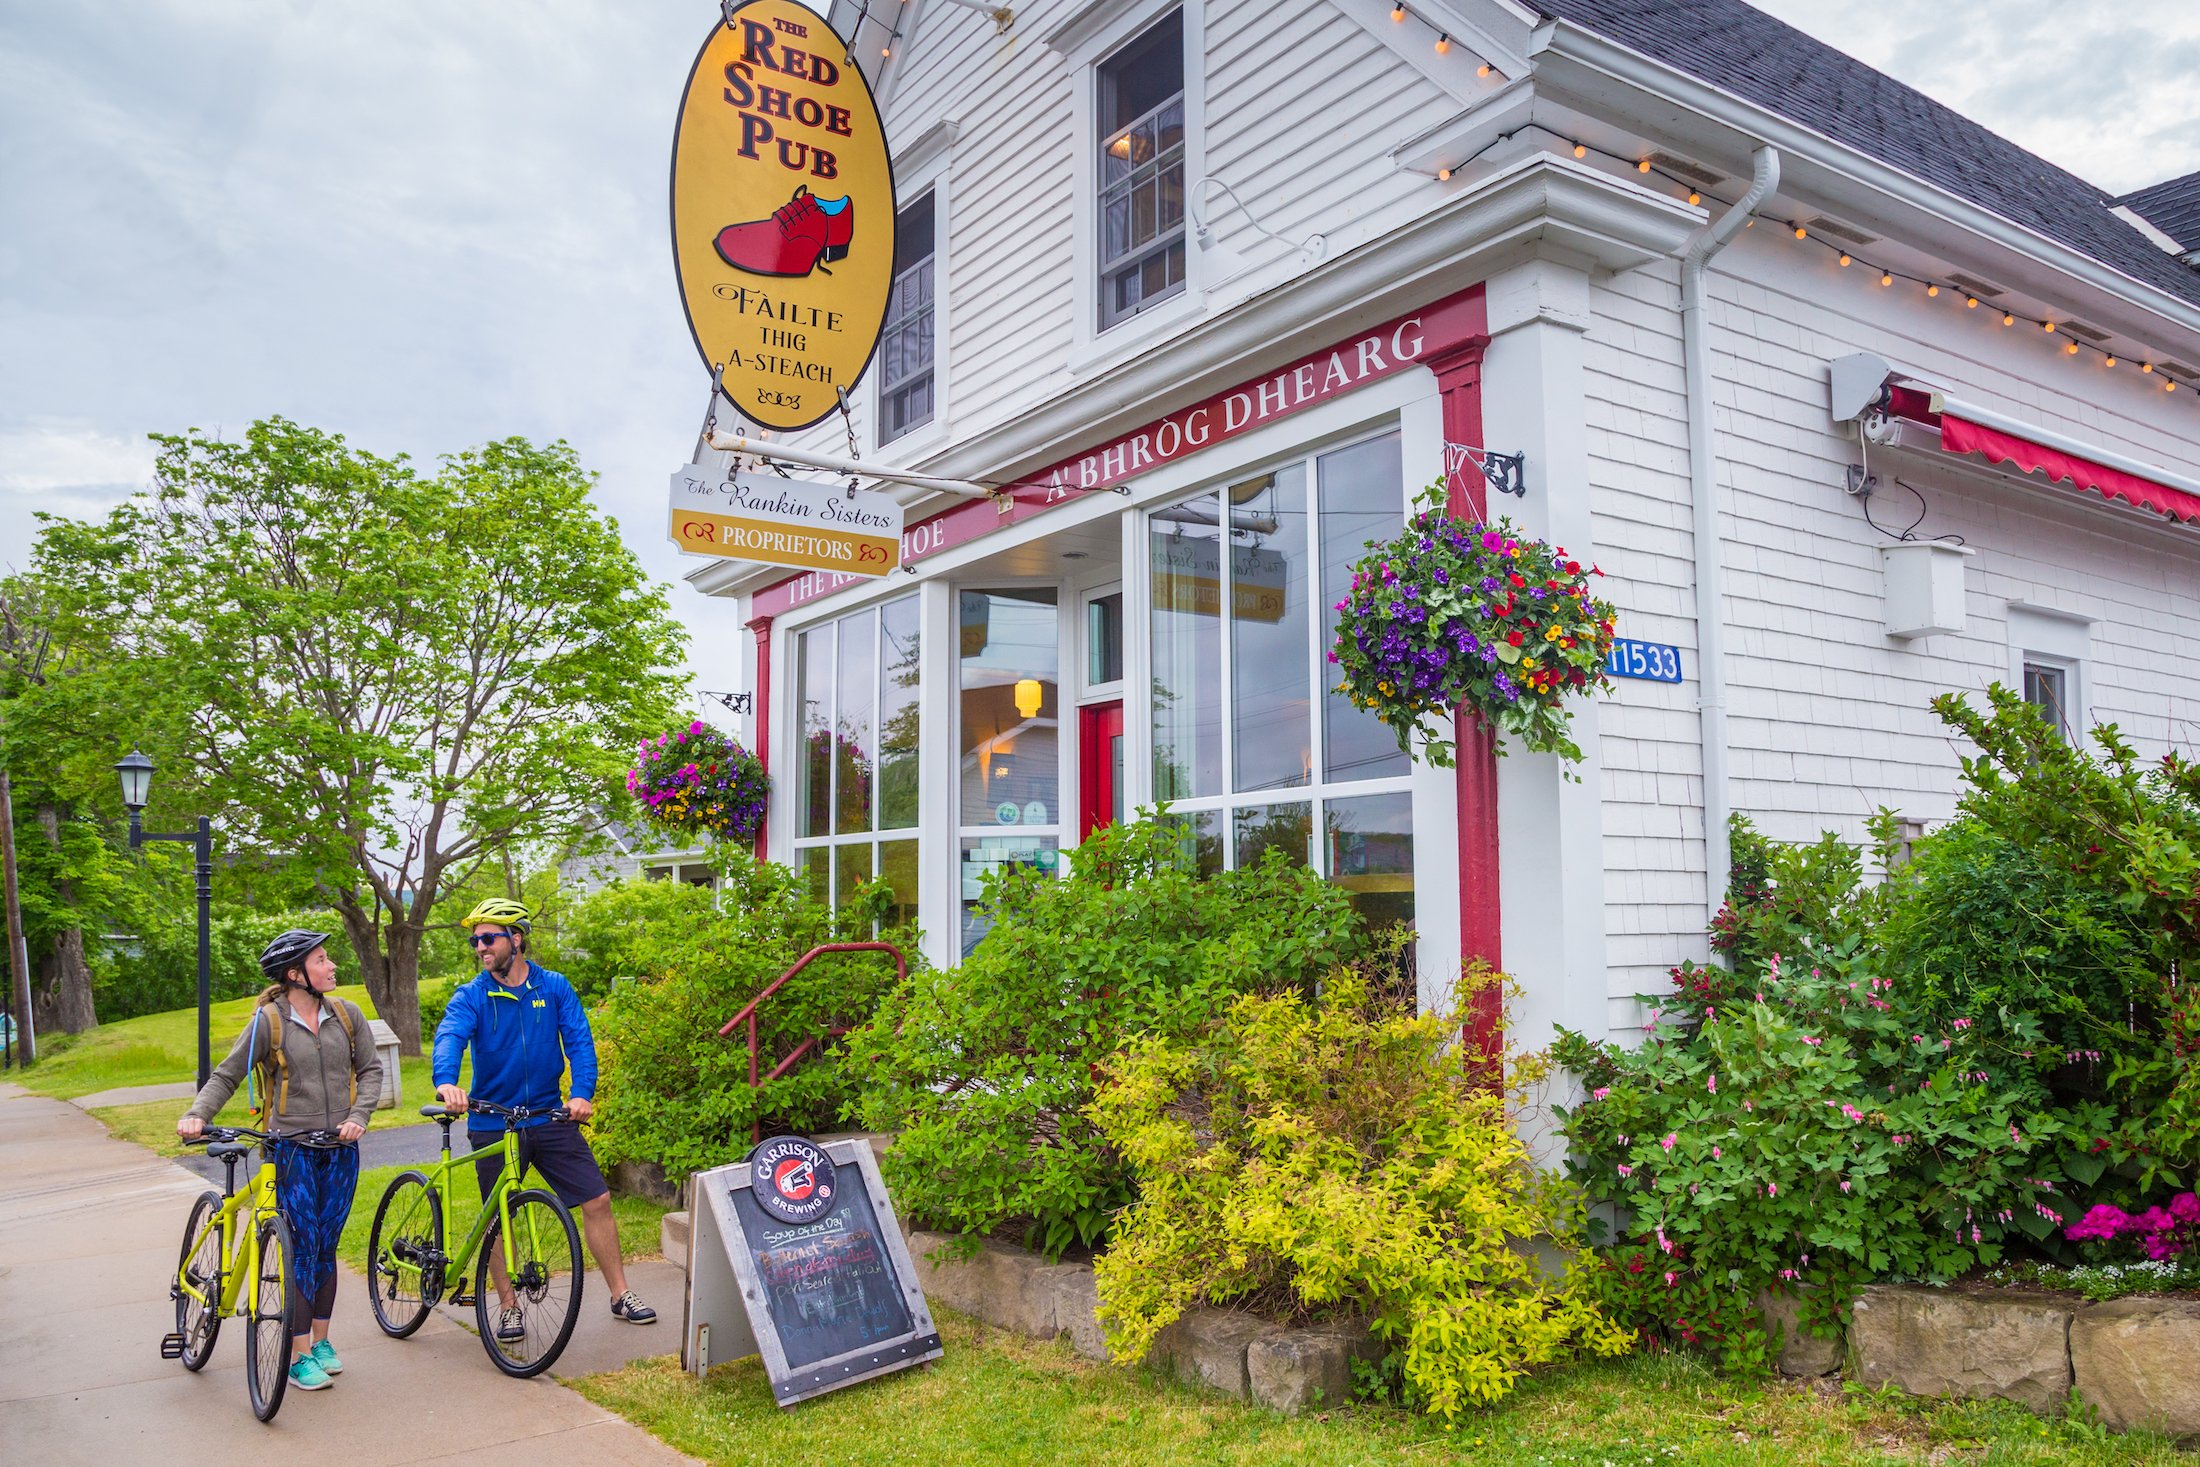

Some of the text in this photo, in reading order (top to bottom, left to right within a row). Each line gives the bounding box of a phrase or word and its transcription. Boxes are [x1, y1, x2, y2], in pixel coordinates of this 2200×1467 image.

[773, 17, 808, 39] THE
[740, 17, 839, 87] RED
[723, 61, 852, 138] SHOE
[737, 110, 838, 180] PUB
[712, 283, 843, 333] FÀILTE
[760, 326, 807, 352] THIG
[729, 349, 832, 384] A-STEACH
[1078, 408, 1210, 490] BHRÒG
[1221, 317, 1424, 433] DHEARG
[684, 477, 894, 528] The Rankin Sisters
[722, 525, 853, 561] PROPRIETORS
[787, 572, 825, 605] THE
[1611, 641, 1677, 679] 11533
[758, 1143, 824, 1180] GARRISON
[772, 1196, 822, 1214] BREWING
[763, 1230, 795, 1244] Soup
[825, 1217, 843, 1229] Day
